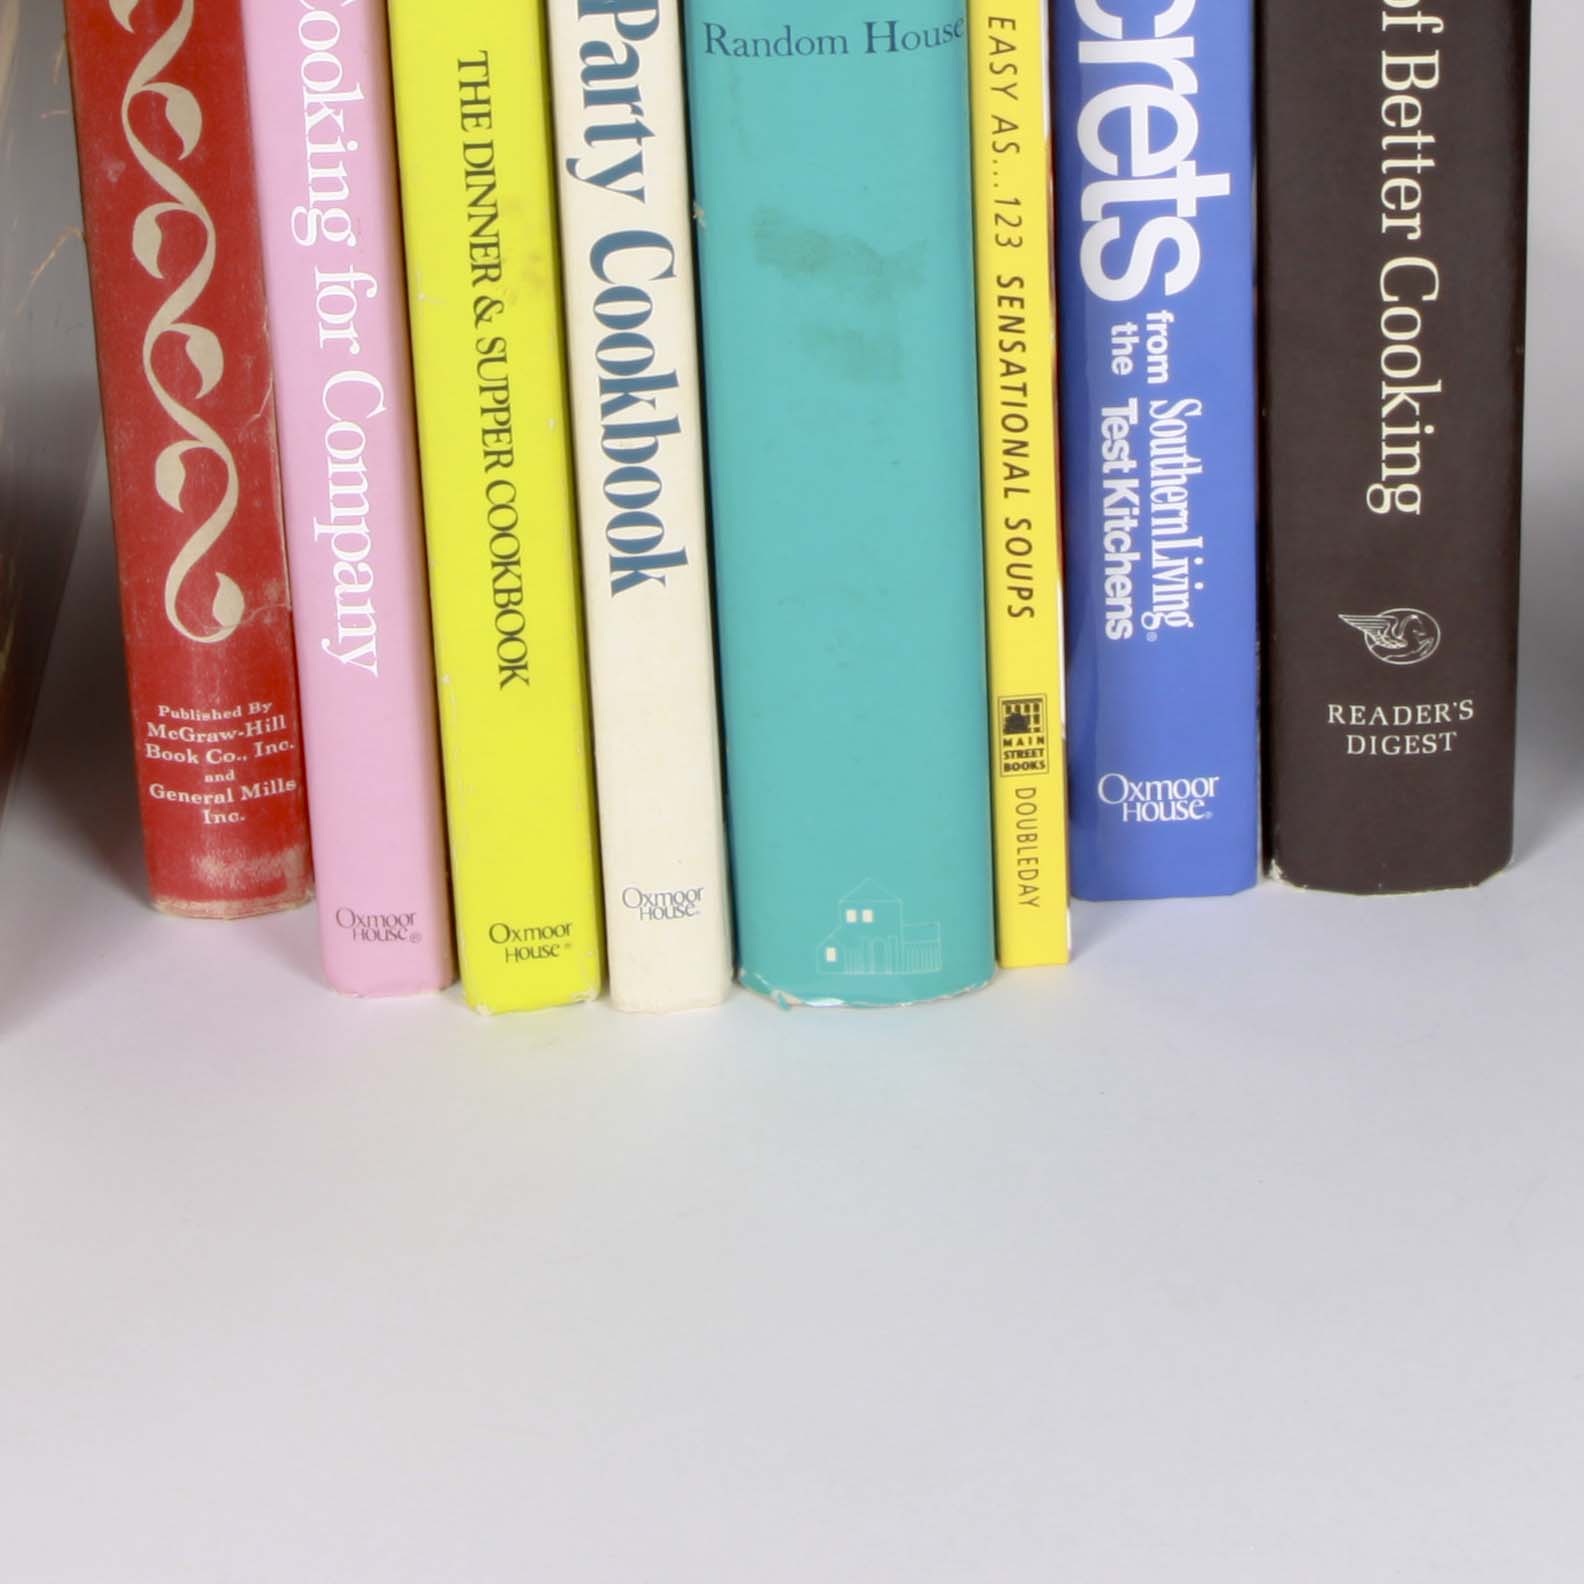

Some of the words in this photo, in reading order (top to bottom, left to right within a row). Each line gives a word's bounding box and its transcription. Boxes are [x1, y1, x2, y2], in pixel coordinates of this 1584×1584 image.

[703, 22, 847, 57] Random
[864, 16, 964, 54] House
[986, 16, 1019, 101] EASY
[456, 49, 491, 132] THE
[1379, 49, 1439, 240] Better
[461, 141, 503, 284] DINNER
[314, 264, 377, 353] for
[472, 294, 506, 329] &
[1111, 322, 1134, 376] the
[1146, 311, 1174, 385] from
[475, 336, 515, 472] SUPPER
[590, 228, 689, 596] Cookbook
[996, 273, 1030, 500] SENSATIONAL
[1366, 256, 1442, 516] Cooking
[1102, 398, 1138, 473] Test
[1150, 398, 1202, 538] Southern
[314, 369, 387, 677] Company
[483, 480, 530, 691] COOKBOOK
[1003, 517, 1035, 620] SOUPS
[1102, 477, 1136, 640] Kitchens
[1141, 538, 1204, 629] Living
[146, 715, 287, 743] McGraw-Hill
[158, 704, 242, 721] Published
[248, 701, 273, 715] By
[1003, 736, 1044, 747] MAIN
[1327, 698, 1474, 726] READER'S
[145, 743, 199, 764] Book
[254, 740, 295, 758] Inc.
[204, 769, 235, 783] and
[1003, 748, 1044, 760] STREET
[1003, 760, 1045, 772] BOOKS
[1346, 731, 1457, 757] DIGEST
[149, 783, 234, 805] General
[240, 779, 297, 801] Mills
[202, 809, 246, 825] Inc.
[1097, 772, 1220, 806] Oxmoor
[1015, 787, 1040, 908] DOUBLEDAY
[336, 907, 416, 930] Oxmoor
[622, 886, 704, 909] Oxmoor
[488, 922, 572, 946] Oxmoor
